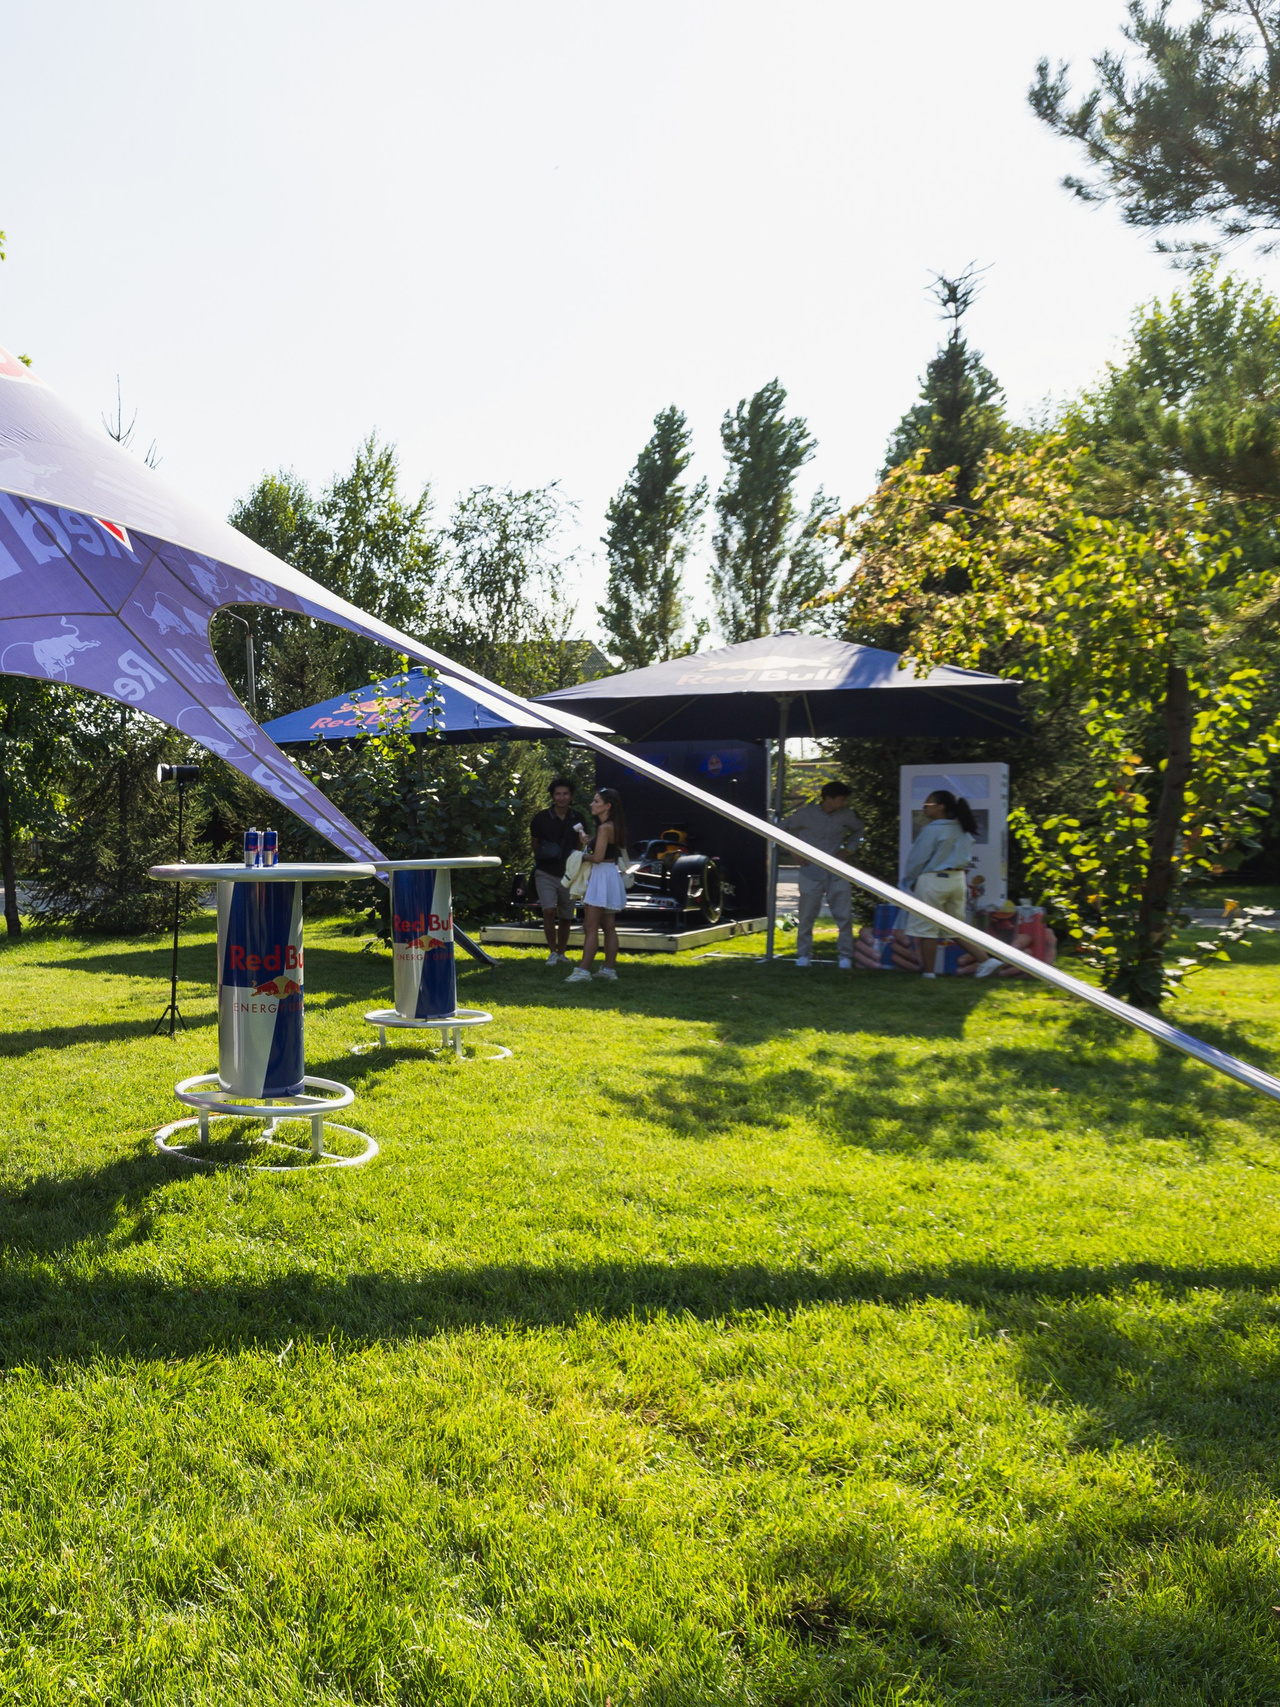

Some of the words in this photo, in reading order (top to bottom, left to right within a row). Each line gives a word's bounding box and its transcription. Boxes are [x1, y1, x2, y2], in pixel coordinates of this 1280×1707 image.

[676, 671, 754, 686] Red
[757, 668, 842, 682] Bull
[309, 712, 365, 730] Red
[393, 912, 425, 932] Red
[428, 912, 453, 932] Bul
[230, 944, 281, 971] Red
[285, 945, 304, 970] Bu
[233, 1002, 284, 1013] ENERGY
